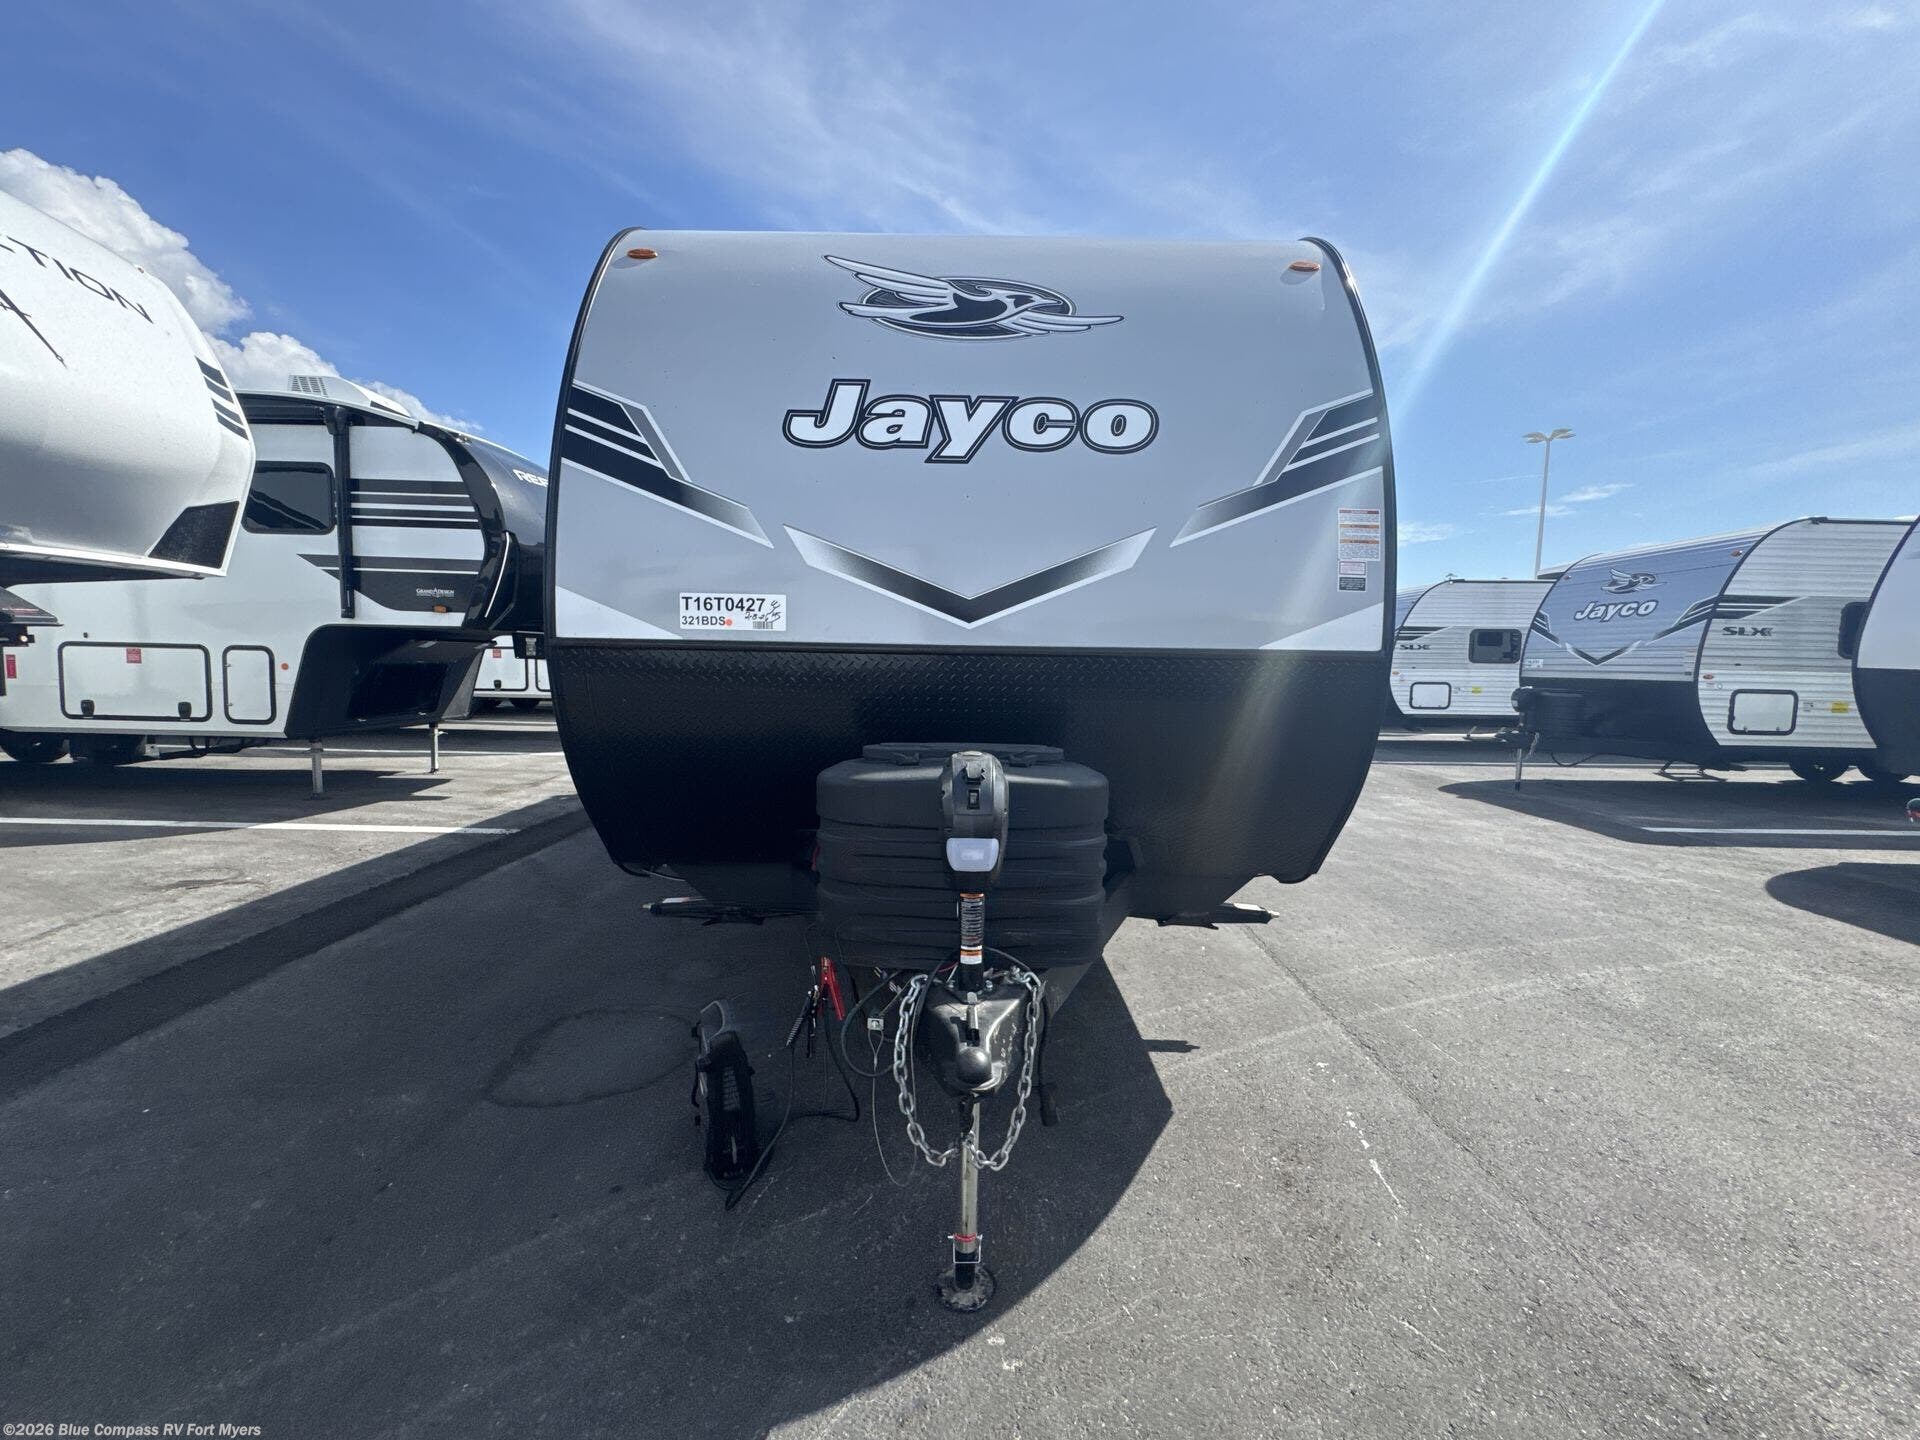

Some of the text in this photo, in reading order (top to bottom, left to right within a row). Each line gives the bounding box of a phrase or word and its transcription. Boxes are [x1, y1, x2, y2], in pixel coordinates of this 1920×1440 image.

[0, 234, 154, 324] TION
[782, 378, 1160, 464] Jayco
[681, 596, 766, 612] T16T0427
[1573, 599, 1659, 623] Jayco
[681, 616, 726, 626] 321BDS
[1722, 626, 1773, 637] SLX
